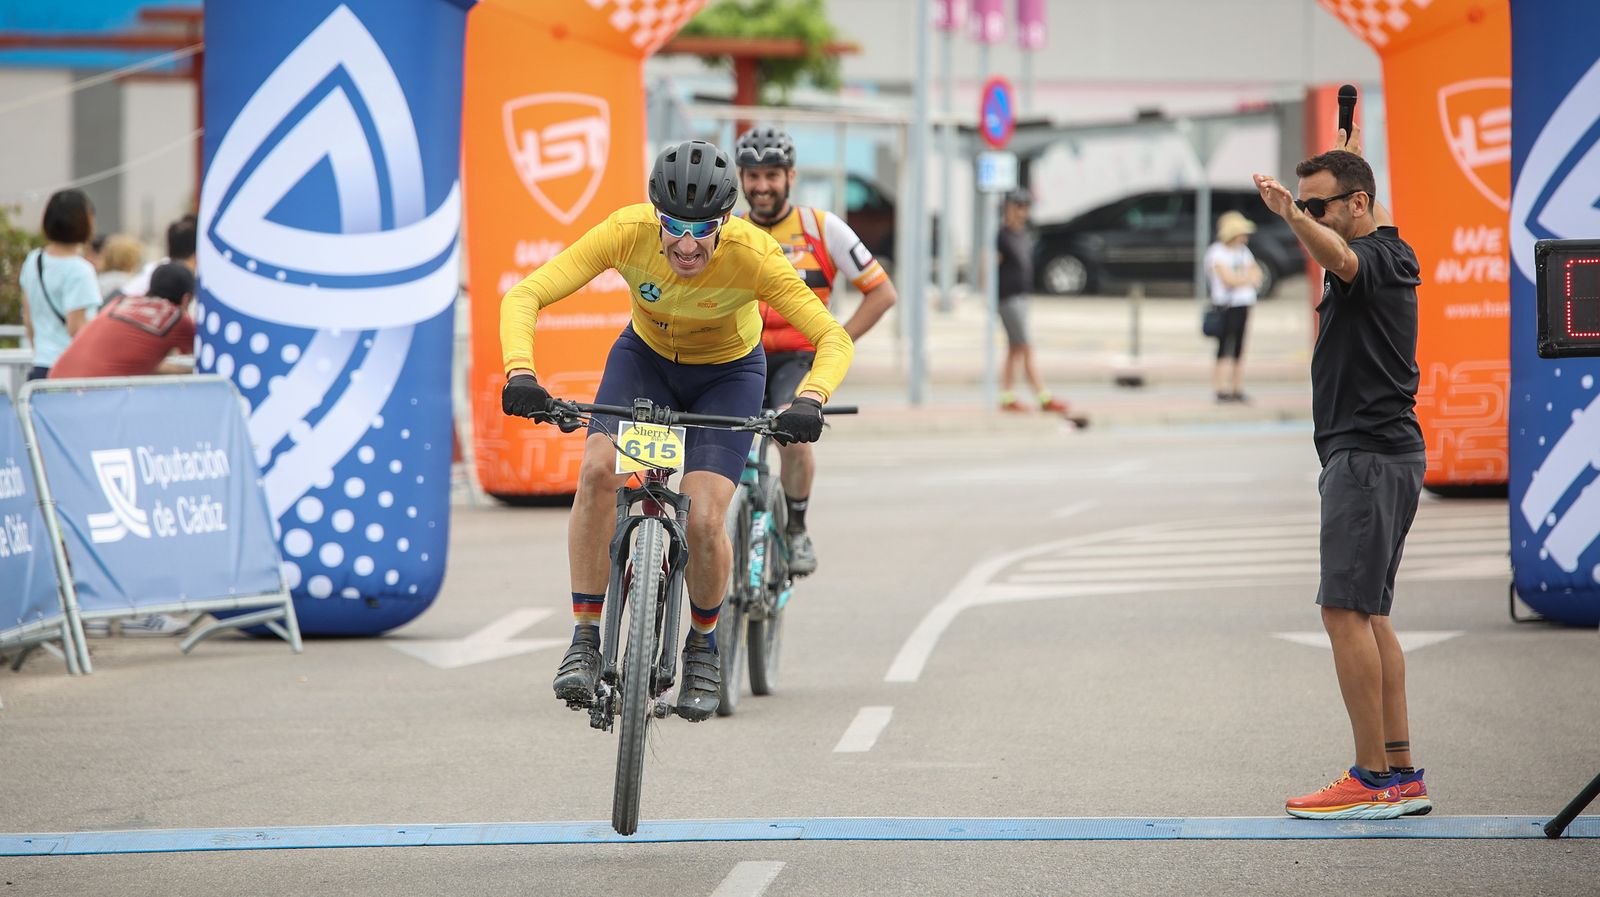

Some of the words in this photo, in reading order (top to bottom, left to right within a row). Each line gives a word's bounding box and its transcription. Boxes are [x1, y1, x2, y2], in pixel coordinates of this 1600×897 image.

[1453, 224, 1502, 254] WE
[633, 426, 670, 441] Sherry
[625, 440, 676, 458] 615
[136, 441, 230, 490] Diputación
[153, 499, 178, 537] de
[177, 494, 228, 535] Cádiz
